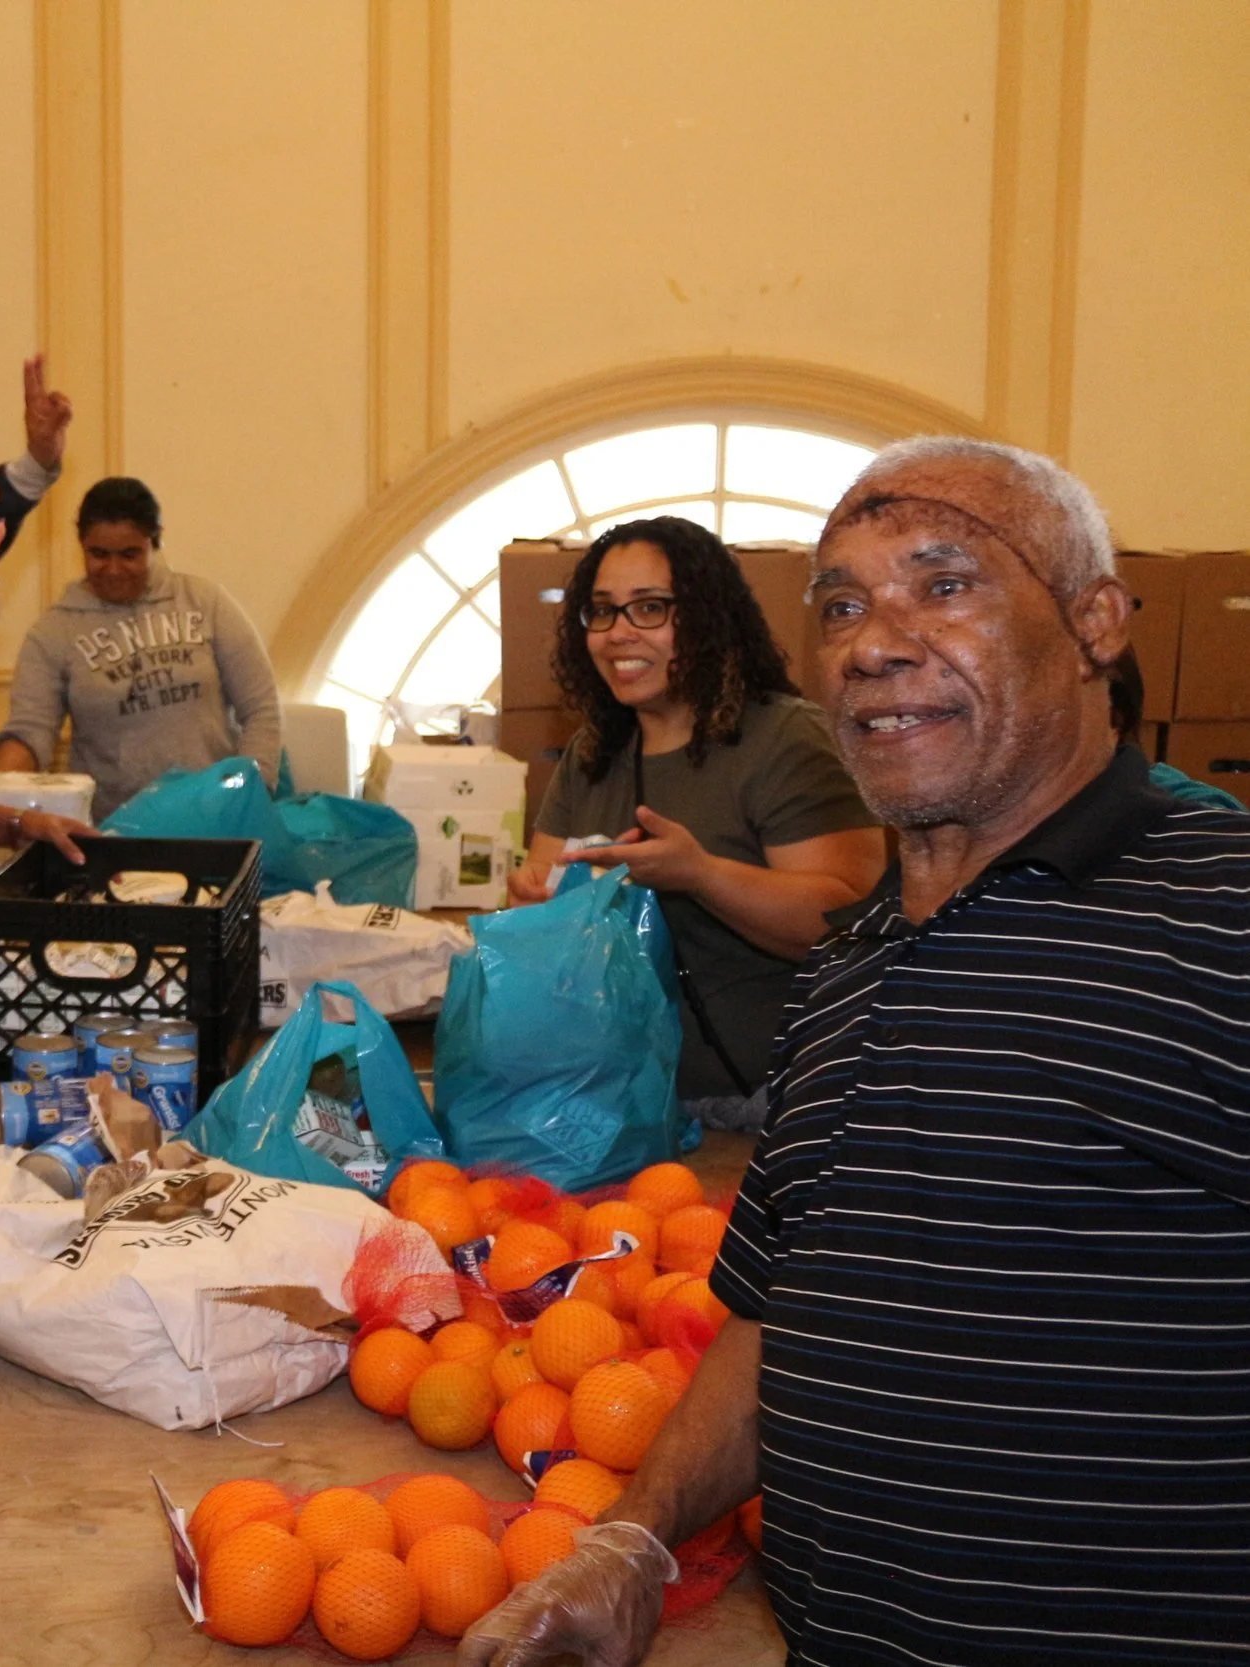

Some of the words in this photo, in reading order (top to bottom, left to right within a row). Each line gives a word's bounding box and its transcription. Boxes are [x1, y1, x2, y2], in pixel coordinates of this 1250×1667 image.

[105, 657, 143, 684] NEW
[145, 648, 194, 666] YORK
[136, 668, 173, 691] CITY
[216, 1180, 299, 1242] MONTE
